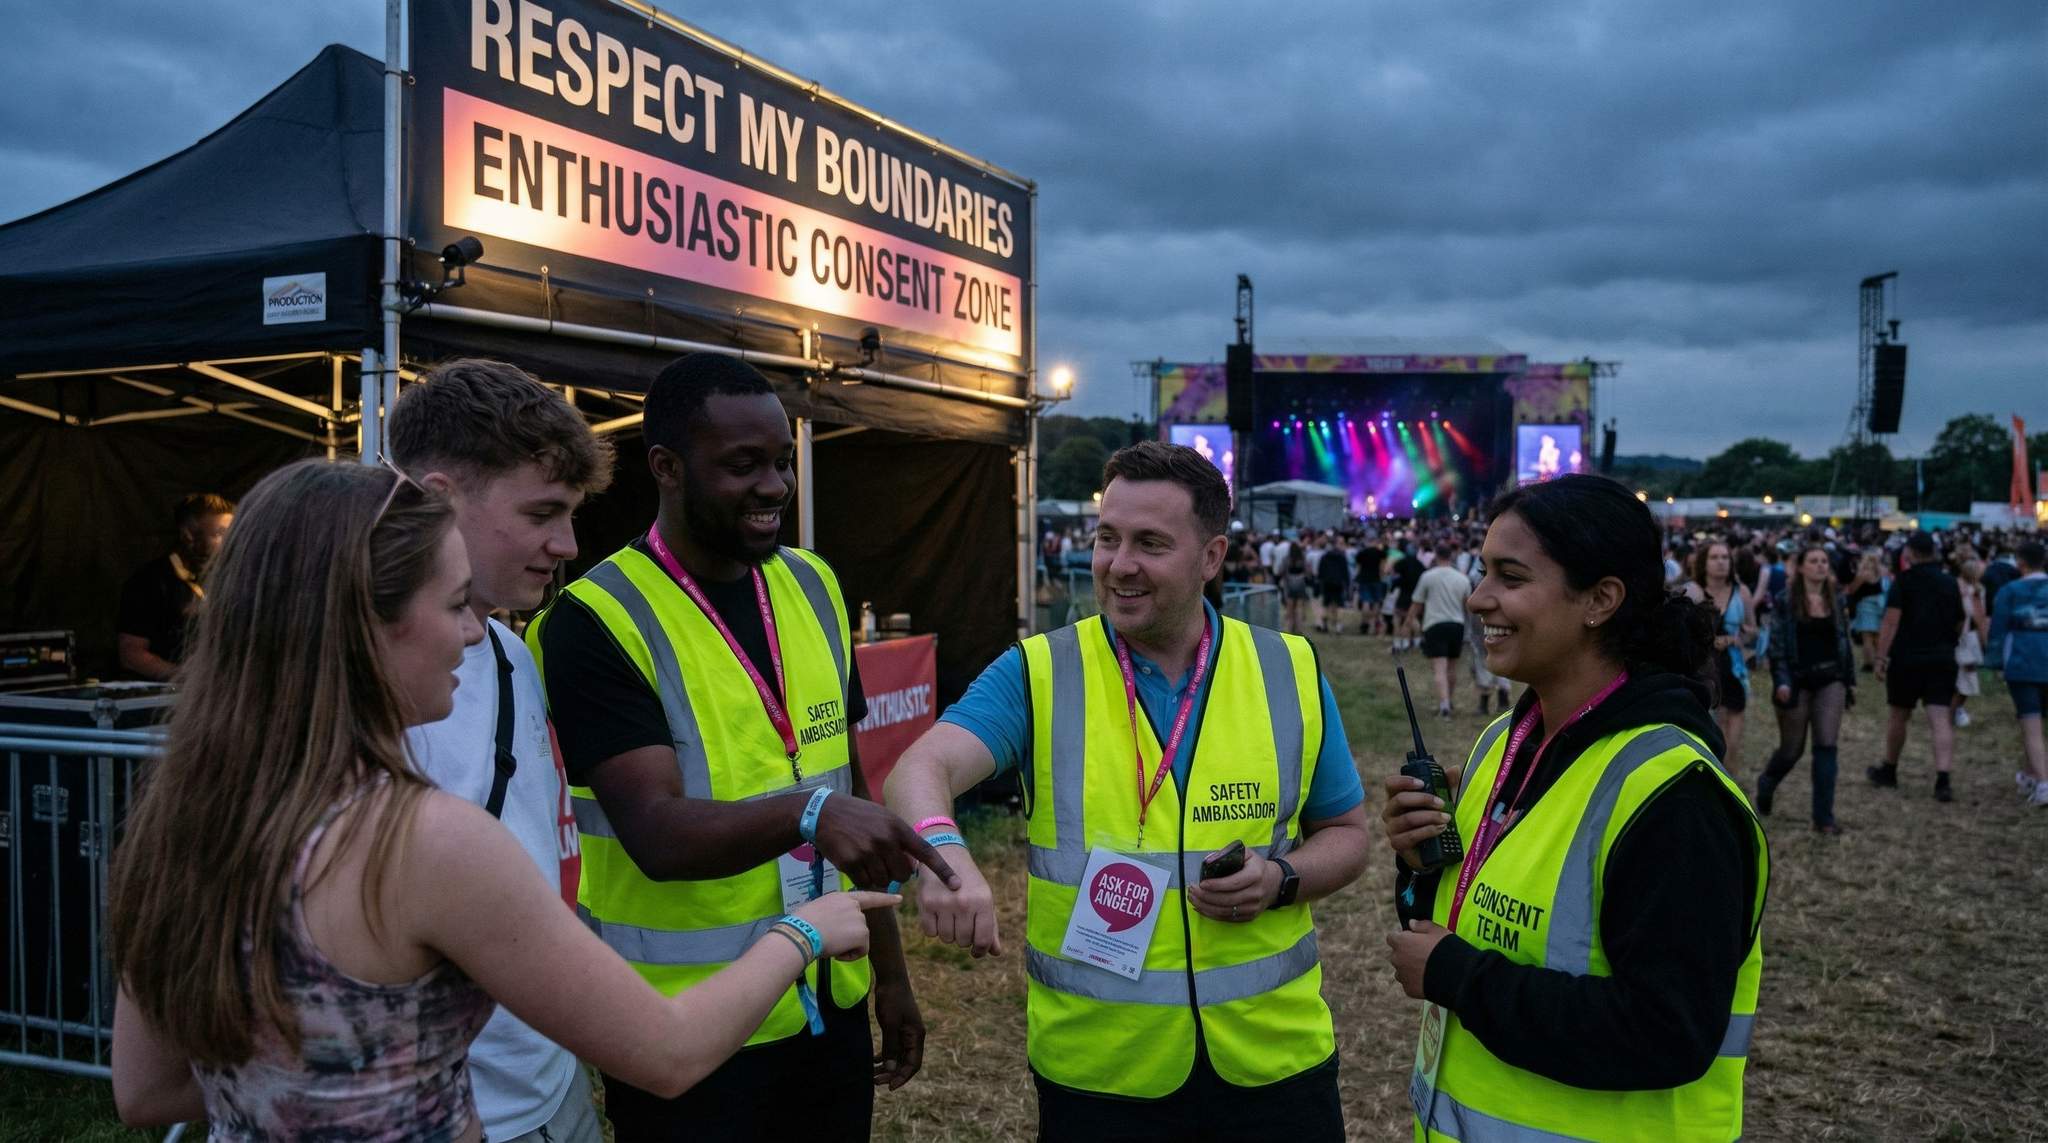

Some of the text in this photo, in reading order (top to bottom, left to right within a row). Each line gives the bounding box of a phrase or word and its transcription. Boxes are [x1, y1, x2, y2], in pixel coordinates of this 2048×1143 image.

[471, 0, 1014, 259] RESPECT MY BOUNDARIES
[473, 120, 1012, 331] ENTHUSIASTIC CONSENT ZONE
[807, 700, 840, 722] SAFETY
[1210, 782, 1260, 801] SAFETY
[1193, 802, 1276, 823] AMBASSADOR
[1098, 873, 1149, 902] ASK FOR
[1094, 889, 1143, 918] ANGELA
[1473, 882, 1545, 931] CONSENT
[1477, 913, 1519, 953] TEAM
